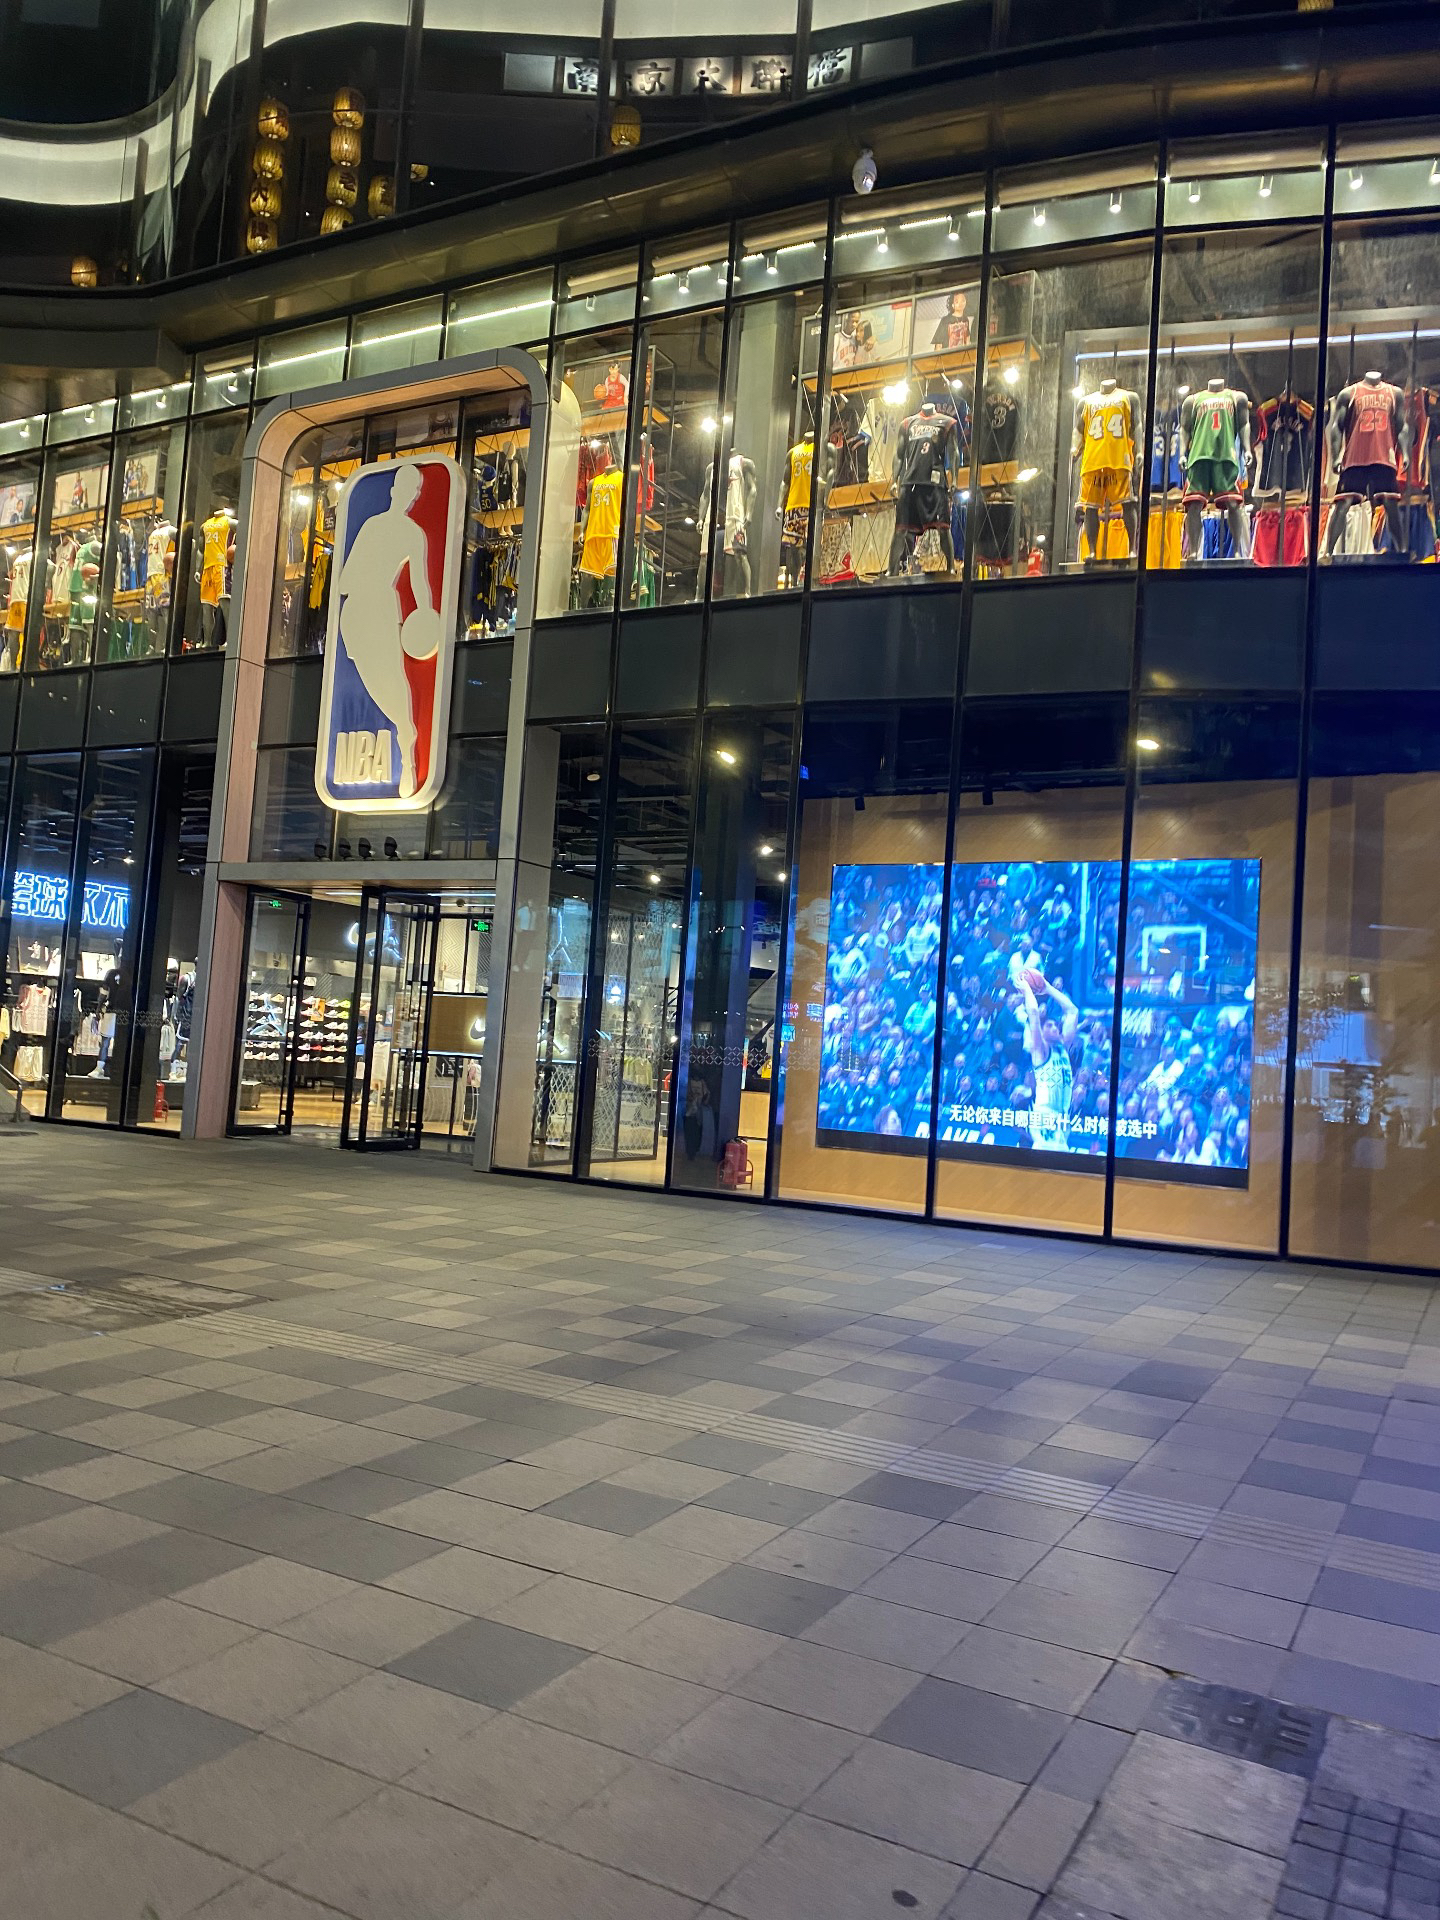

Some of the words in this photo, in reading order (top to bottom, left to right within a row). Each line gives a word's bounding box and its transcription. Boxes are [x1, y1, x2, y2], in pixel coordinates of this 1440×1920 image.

[1355, 394, 1392, 414] BULLS
[991, 406, 1007, 428] 3
[1088, 413, 1123, 439] 44
[1211, 411, 1221, 431] 1
[1360, 410, 1388, 432] 23
[920, 441, 930, 455] 3
[593, 492, 611, 507] 34
[205, 531, 220, 545] 24
[333, 729, 392, 784] NBA
